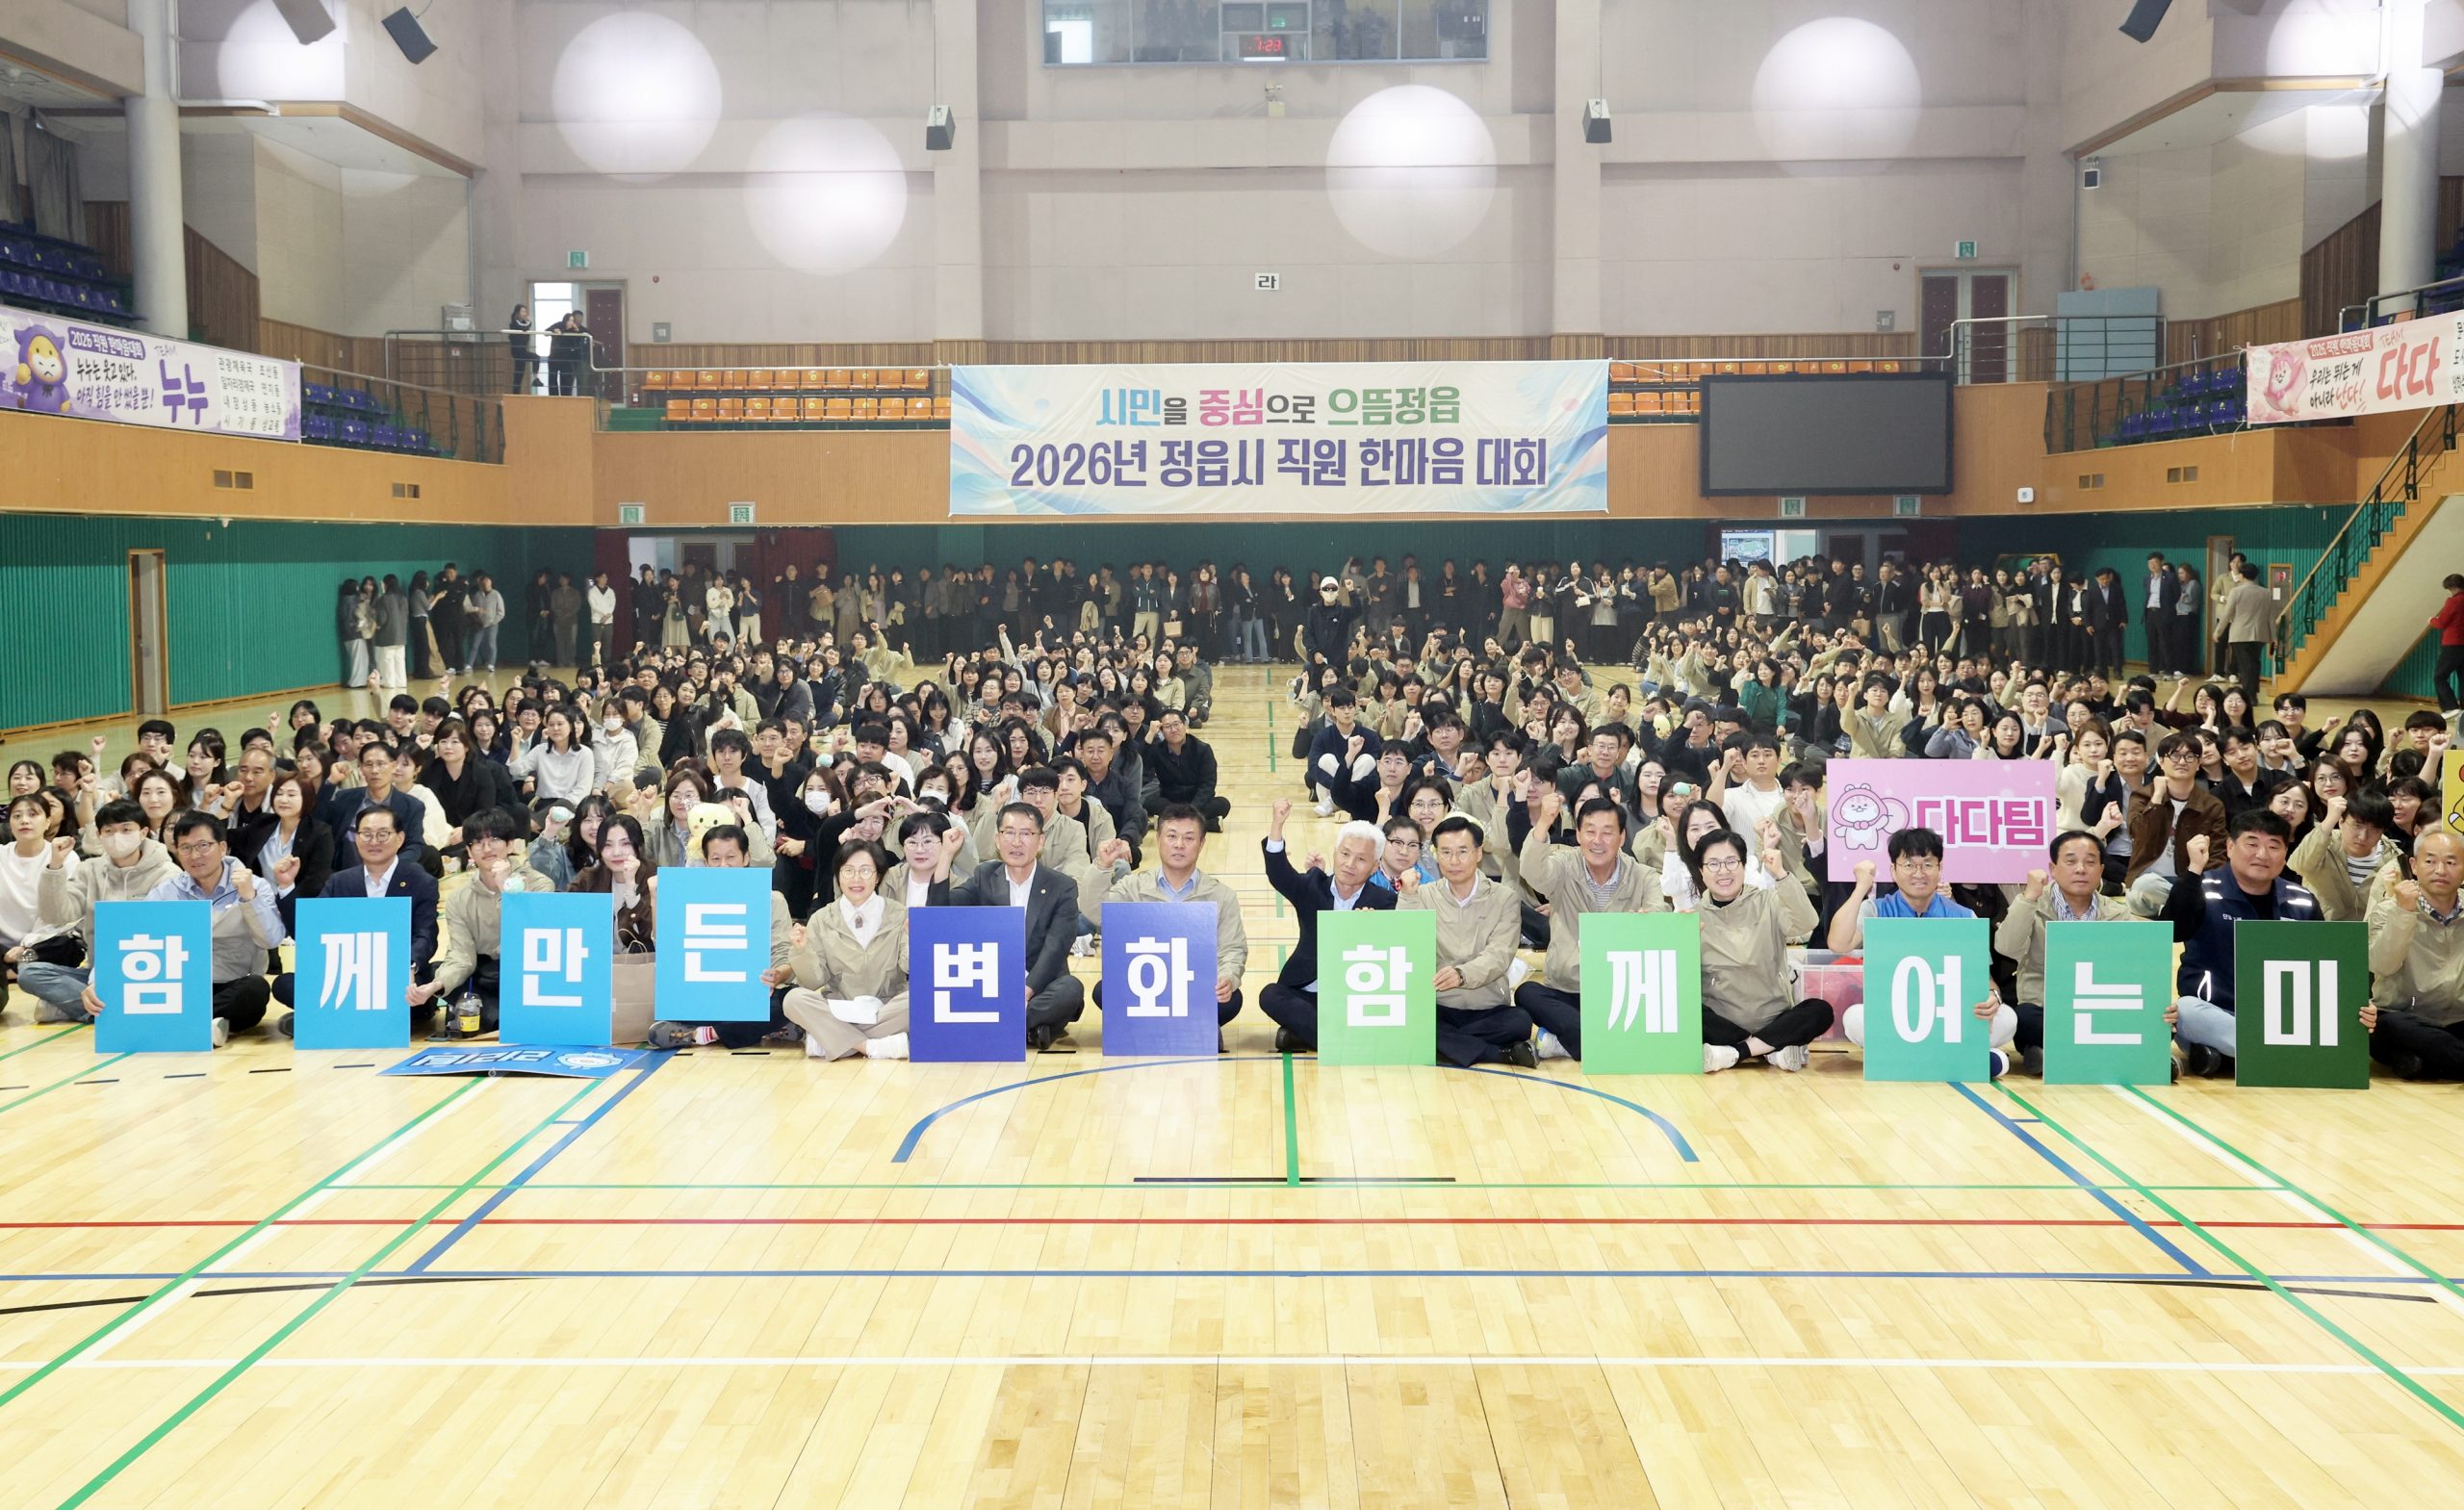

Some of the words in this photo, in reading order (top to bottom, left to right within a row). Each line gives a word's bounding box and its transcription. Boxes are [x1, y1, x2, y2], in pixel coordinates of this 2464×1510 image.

[1258, 275, 1277, 289] 라
[70, 330, 93, 348] 2026
[93, 333, 109, 353] 직원
[108, 334, 144, 359] 한마음대회
[76, 357, 100, 382] 누누는
[103, 359, 117, 382] 웃고
[118, 362, 138, 383] 있다.
[2309, 343, 2327, 357] 2026
[2310, 366, 2332, 389] 우리는
[2333, 361, 2350, 383] 뛰는
[2351, 357, 2364, 376] 게
[2376, 336, 2440, 400] 다다
[76, 385, 94, 409] 아직
[95, 385, 112, 410] 힘을
[114, 387, 123, 408] 안
[159, 359, 209, 425] 누누
[1095, 388, 1187, 426] 시민을
[1199, 387, 1315, 426] 중심으로
[1327, 386, 1461, 425] 으뜸정읍
[2310, 387, 2335, 410] 아니라
[2335, 378, 2366, 410] 난다!
[1011, 440, 1147, 487] 2026년
[1160, 438, 1265, 487] 정읍시
[1277, 438, 1347, 486] 직원
[1359, 437, 1465, 486] 한마음
[1476, 437, 1547, 486] 대회
[1915, 799, 2044, 846] 다다팀
[119, 934, 189, 1014] 함
[320, 932, 388, 1011] 께
[523, 928, 589, 1007] 만
[683, 903, 748, 983] 든
[934, 942, 1000, 1023] 변
[1125, 936, 1194, 1017] 화
[1342, 944, 1414, 1028] 함
[1605, 949, 1679, 1034] 께
[1891, 955, 1962, 1043] 여
[2072, 961, 2143, 1044] 는
[2264, 960, 2338, 1046] 미
